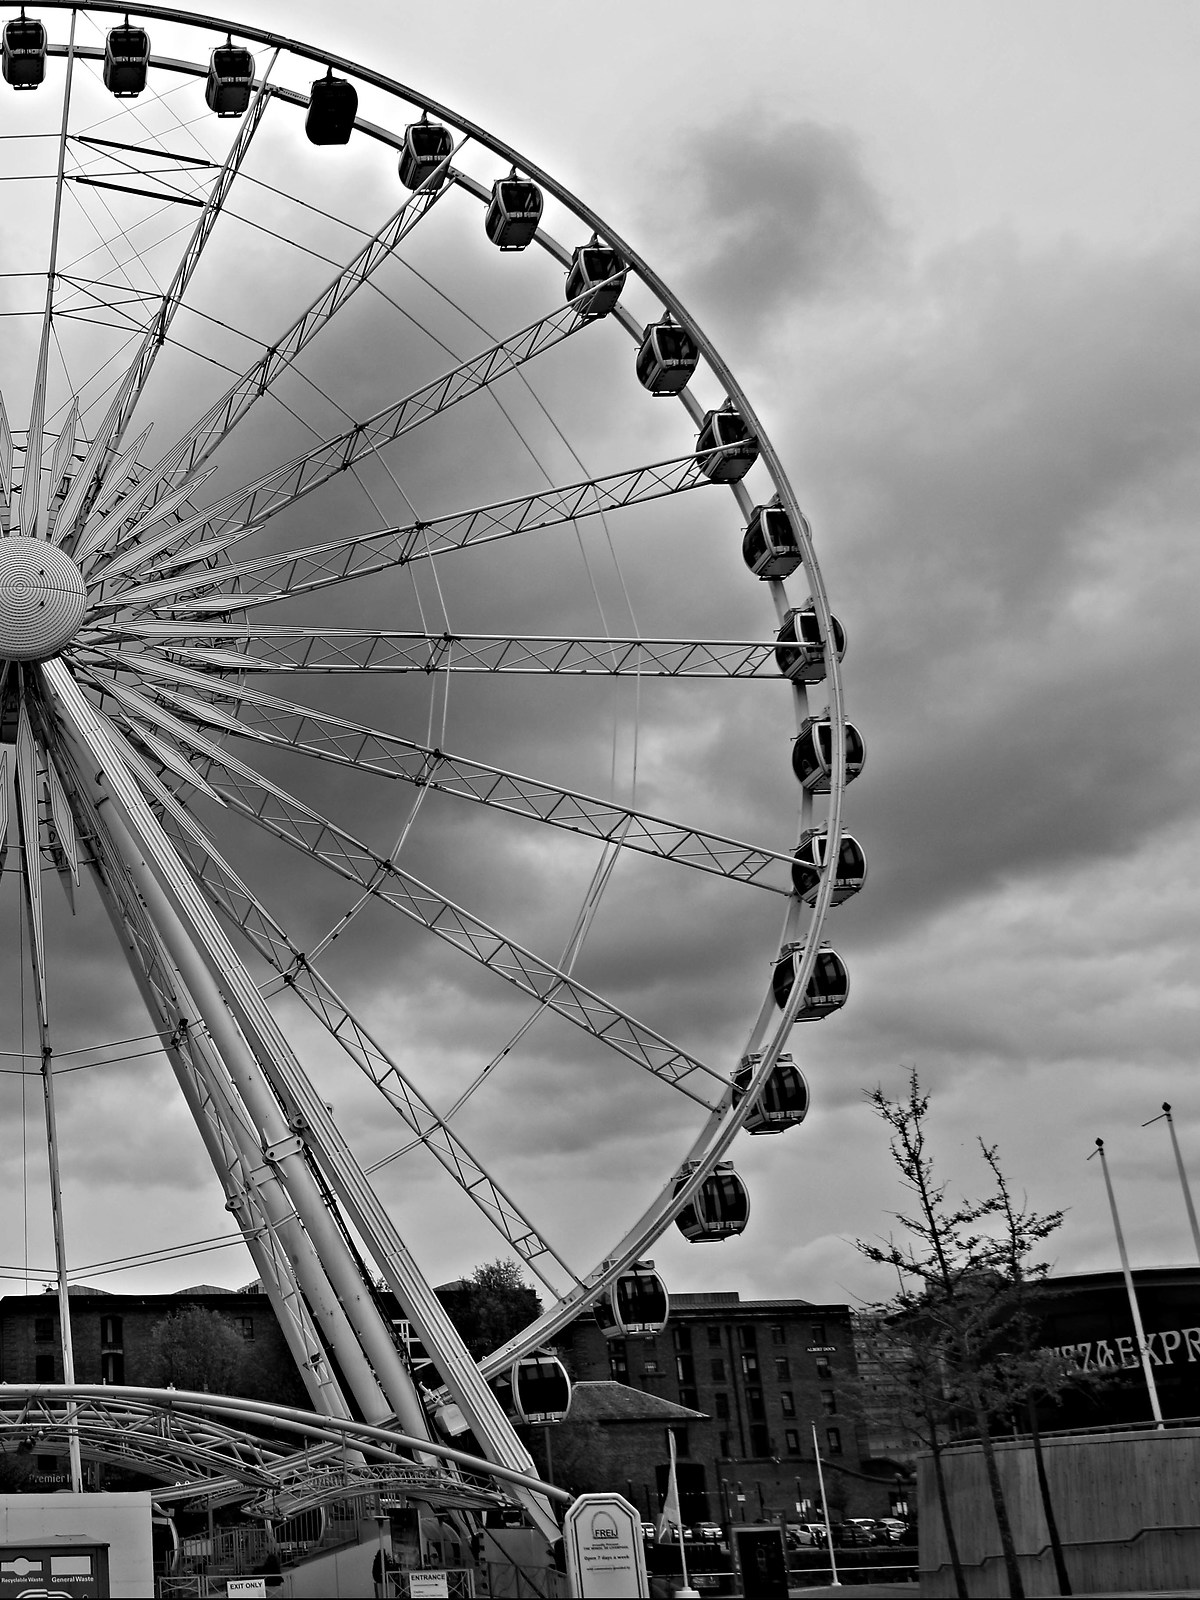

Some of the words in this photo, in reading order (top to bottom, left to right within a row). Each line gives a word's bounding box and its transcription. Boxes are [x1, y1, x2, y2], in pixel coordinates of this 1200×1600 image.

[595, 1529, 618, 1537] FREIJ
[410, 1573, 446, 1581] ENTRANCE
[229, 1582, 244, 1590] EXIT
[245, 1581, 263, 1589] ONLY
